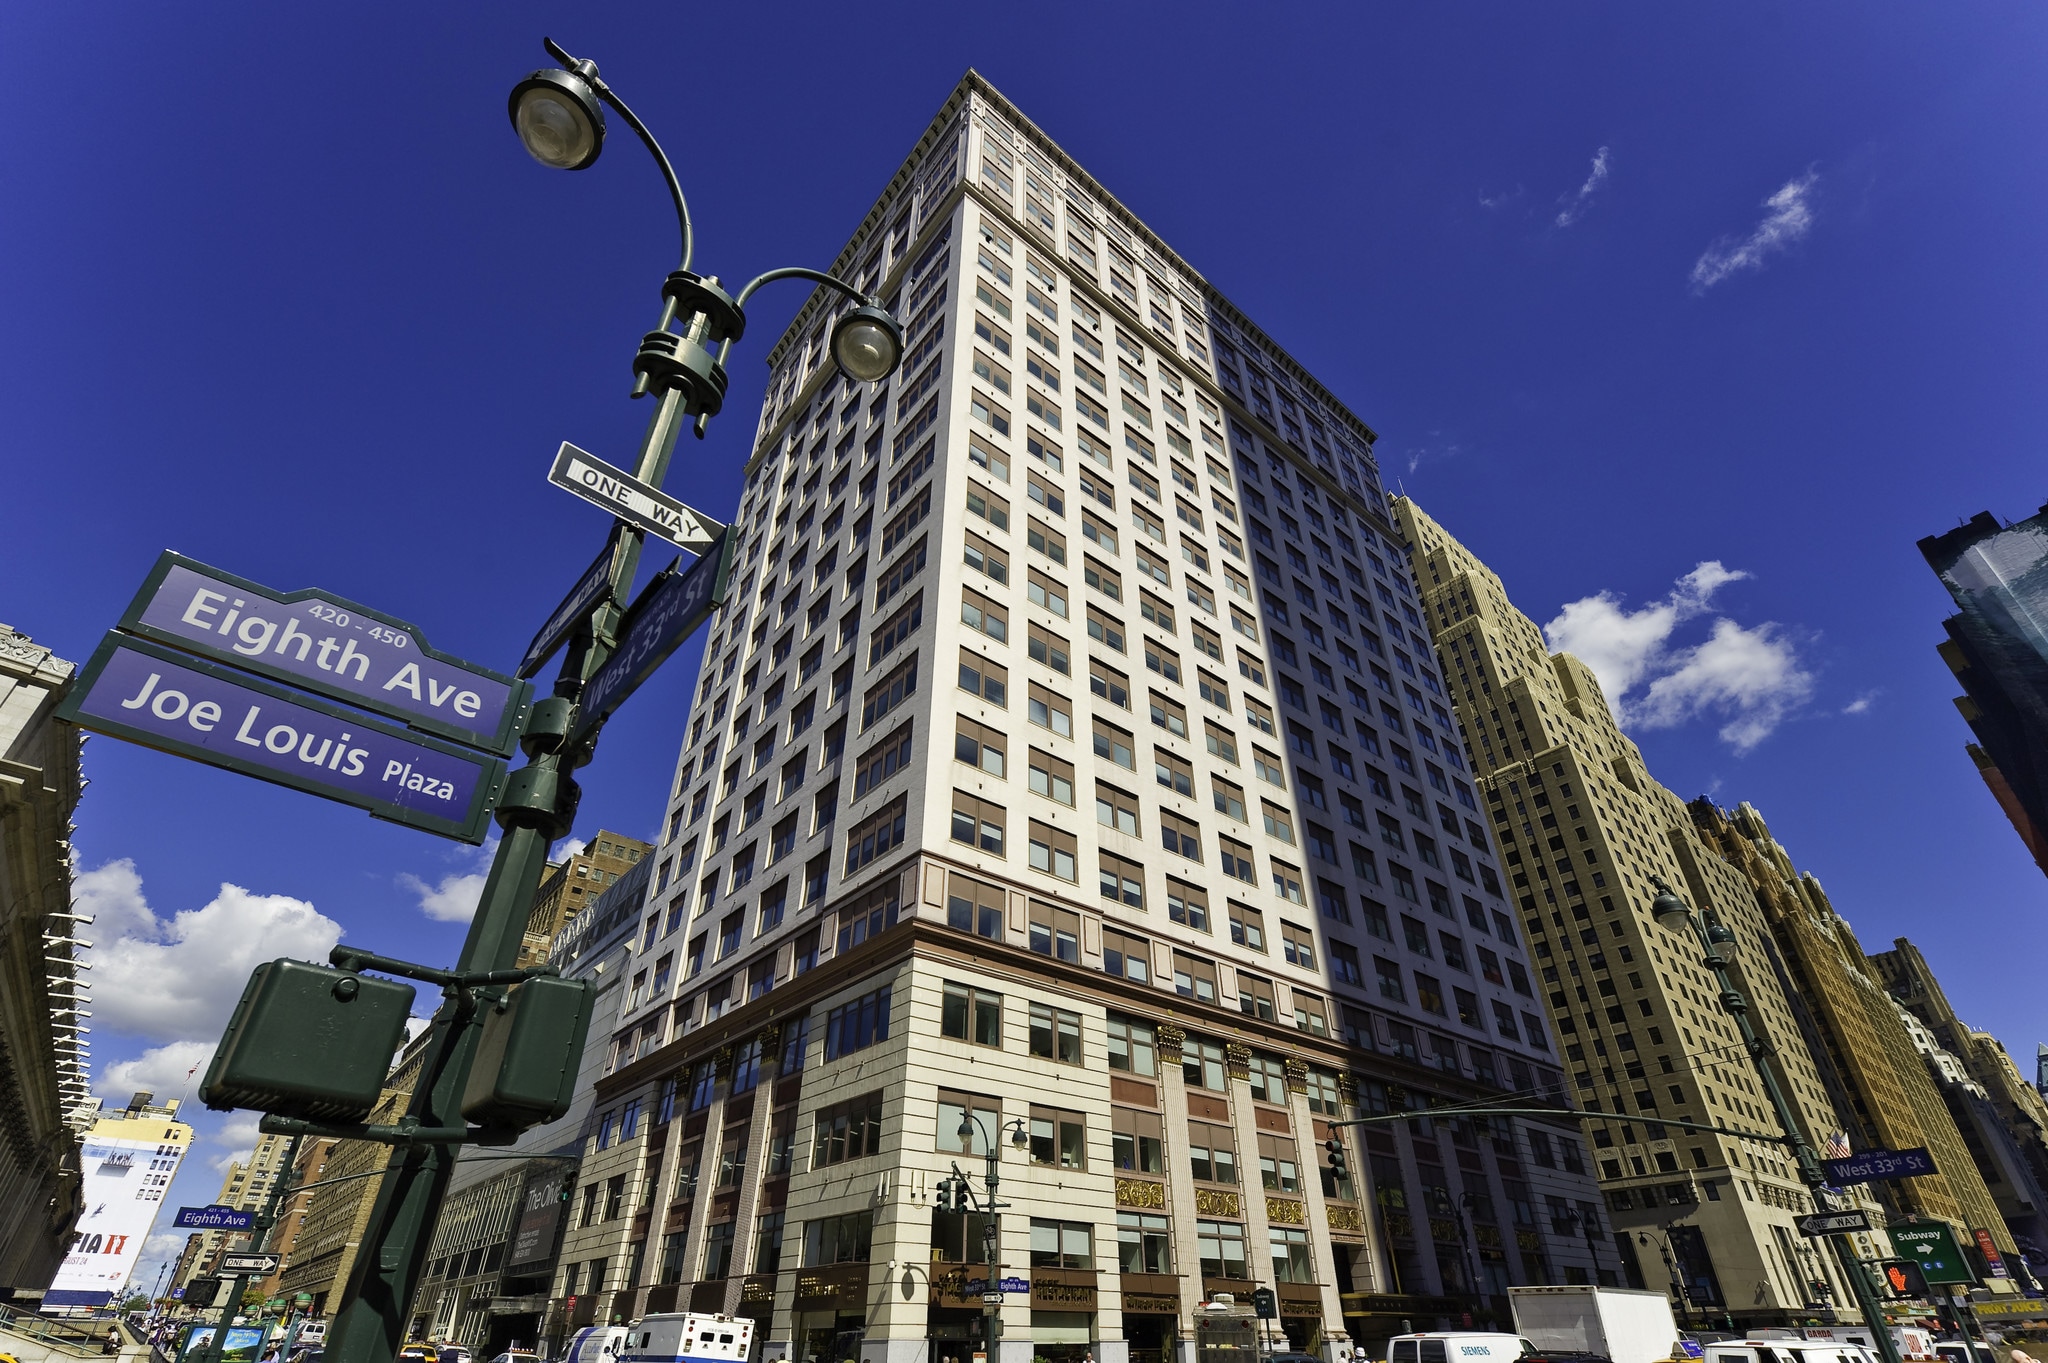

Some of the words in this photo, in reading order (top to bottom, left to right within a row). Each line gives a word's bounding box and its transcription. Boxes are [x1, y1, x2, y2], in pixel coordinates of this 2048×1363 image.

[582, 469, 632, 505] ONE
[653, 503, 700, 537] WAY
[308, 604, 350, 628] 420
[368, 626, 408, 648] 450
[587, 649, 636, 713] West
[637, 598, 679, 664] 33rd
[681, 568, 708, 616] St
[181, 587, 370, 682] Eighth
[382, 662, 481, 718] Ave
[121, 672, 222, 732] Joe
[234, 705, 369, 777] Louis
[382, 759, 455, 801] Plaza
[1834, 1162, 1875, 1178] West
[1874, 1156, 1903, 1173] 33rd
[1906, 1155, 1925, 1169] St
[526, 1187, 542, 1212] The
[541, 1179, 563, 1208] Olivi
[183, 1212, 223, 1226] Eighth
[223, 1215, 246, 1226] Ave
[1806, 1219, 1828, 1229] ONE
[1834, 1216, 1859, 1227] WAY
[67, 1233, 103, 1254] FIA
[1897, 1230, 1941, 1242] Subway
[227, 1259, 243, 1267] ONE
[1001, 1282, 1016, 1290] Eighth
[1976, 1302, 2008, 1315] FRUIT
[2011, 1301, 2044, 1313] JUICE
[1807, 1329, 1833, 1338] GARDA
[1461, 1346, 1491, 1356] SIEMENS
